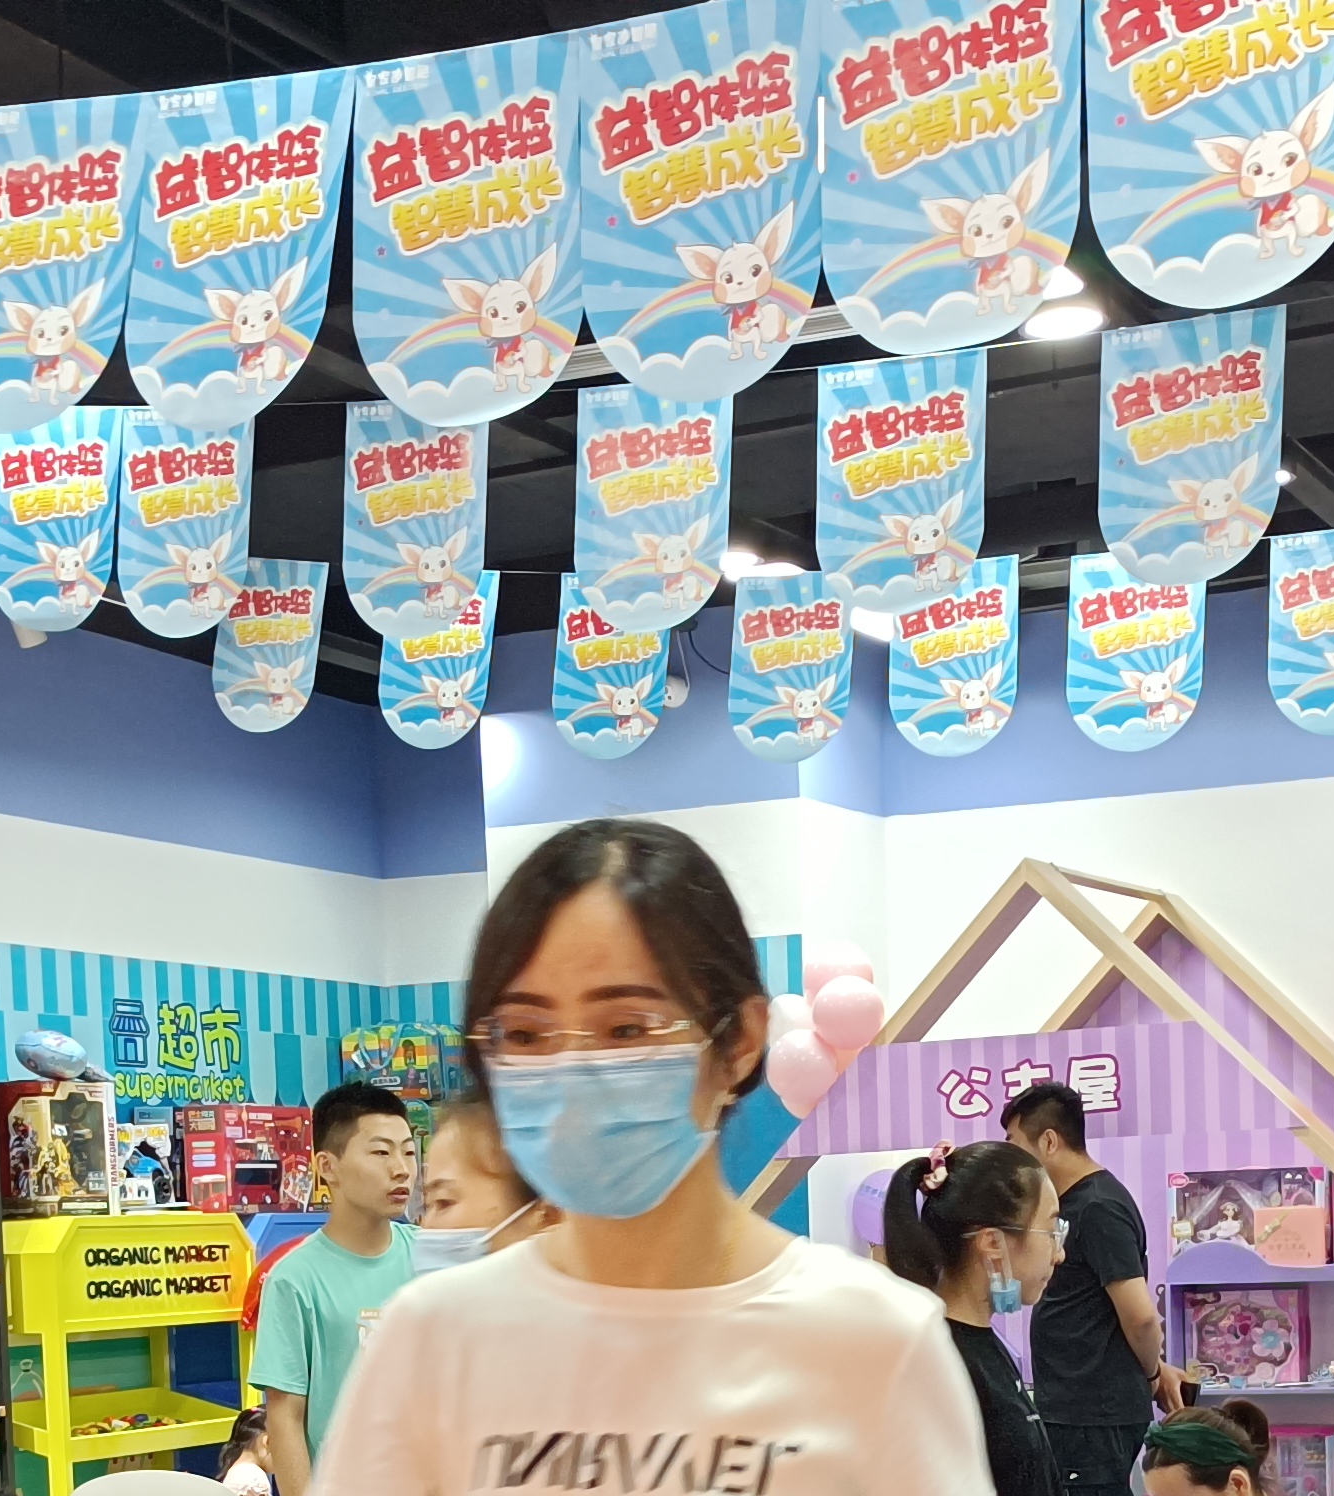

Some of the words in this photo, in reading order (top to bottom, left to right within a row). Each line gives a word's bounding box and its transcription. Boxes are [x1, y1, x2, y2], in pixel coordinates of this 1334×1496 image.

[837, 0, 1048, 123] 益智体验
[597, 53, 791, 169] 益智体验
[865, 59, 1057, 173] 智慧成长
[157, 126, 321, 217] 益智体验
[369, 98, 552, 201] 益智体验
[623, 115, 800, 219] 智慧成长
[171, 180, 319, 263] 智慧成长
[393, 159, 561, 250] 智慧成长
[1114, 353, 1260, 426] 益智体验
[589, 420, 710, 478] 益智体验
[830, 394, 963, 461] 益智体验
[1131, 395, 1265, 458] 智慧成长
[2, 443, 103, 489] 益智体验
[130, 443, 234, 490] 益智体验
[355, 433, 469, 490] 益智体验
[602, 459, 715, 510] 智慧成长
[846, 434, 968, 494] 智慧成长
[12, 481, 104, 521] 智慧成长
[140, 481, 237, 523] 智慧成长
[368, 478, 472, 522] 智慧成长
[745, 604, 839, 641] 益智体验
[1080, 587, 1187, 628] 益智体验
[1093, 613, 1190, 654] 智慧成长
[753, 634, 840, 669] 智慧成长
[913, 622, 1005, 664] 智慧成长
[158, 1001, 241, 1072] 超市
[115, 1071, 245, 1103] supermarket
[108, 1116, 116, 1187] TRANSFORMERS
[84, 1246, 162, 1267] ORGANIC
[165, 1244, 230, 1264] MARKET
[86, 1278, 163, 1299] ORGANIC
[166, 1275, 231, 1295] MARKET
